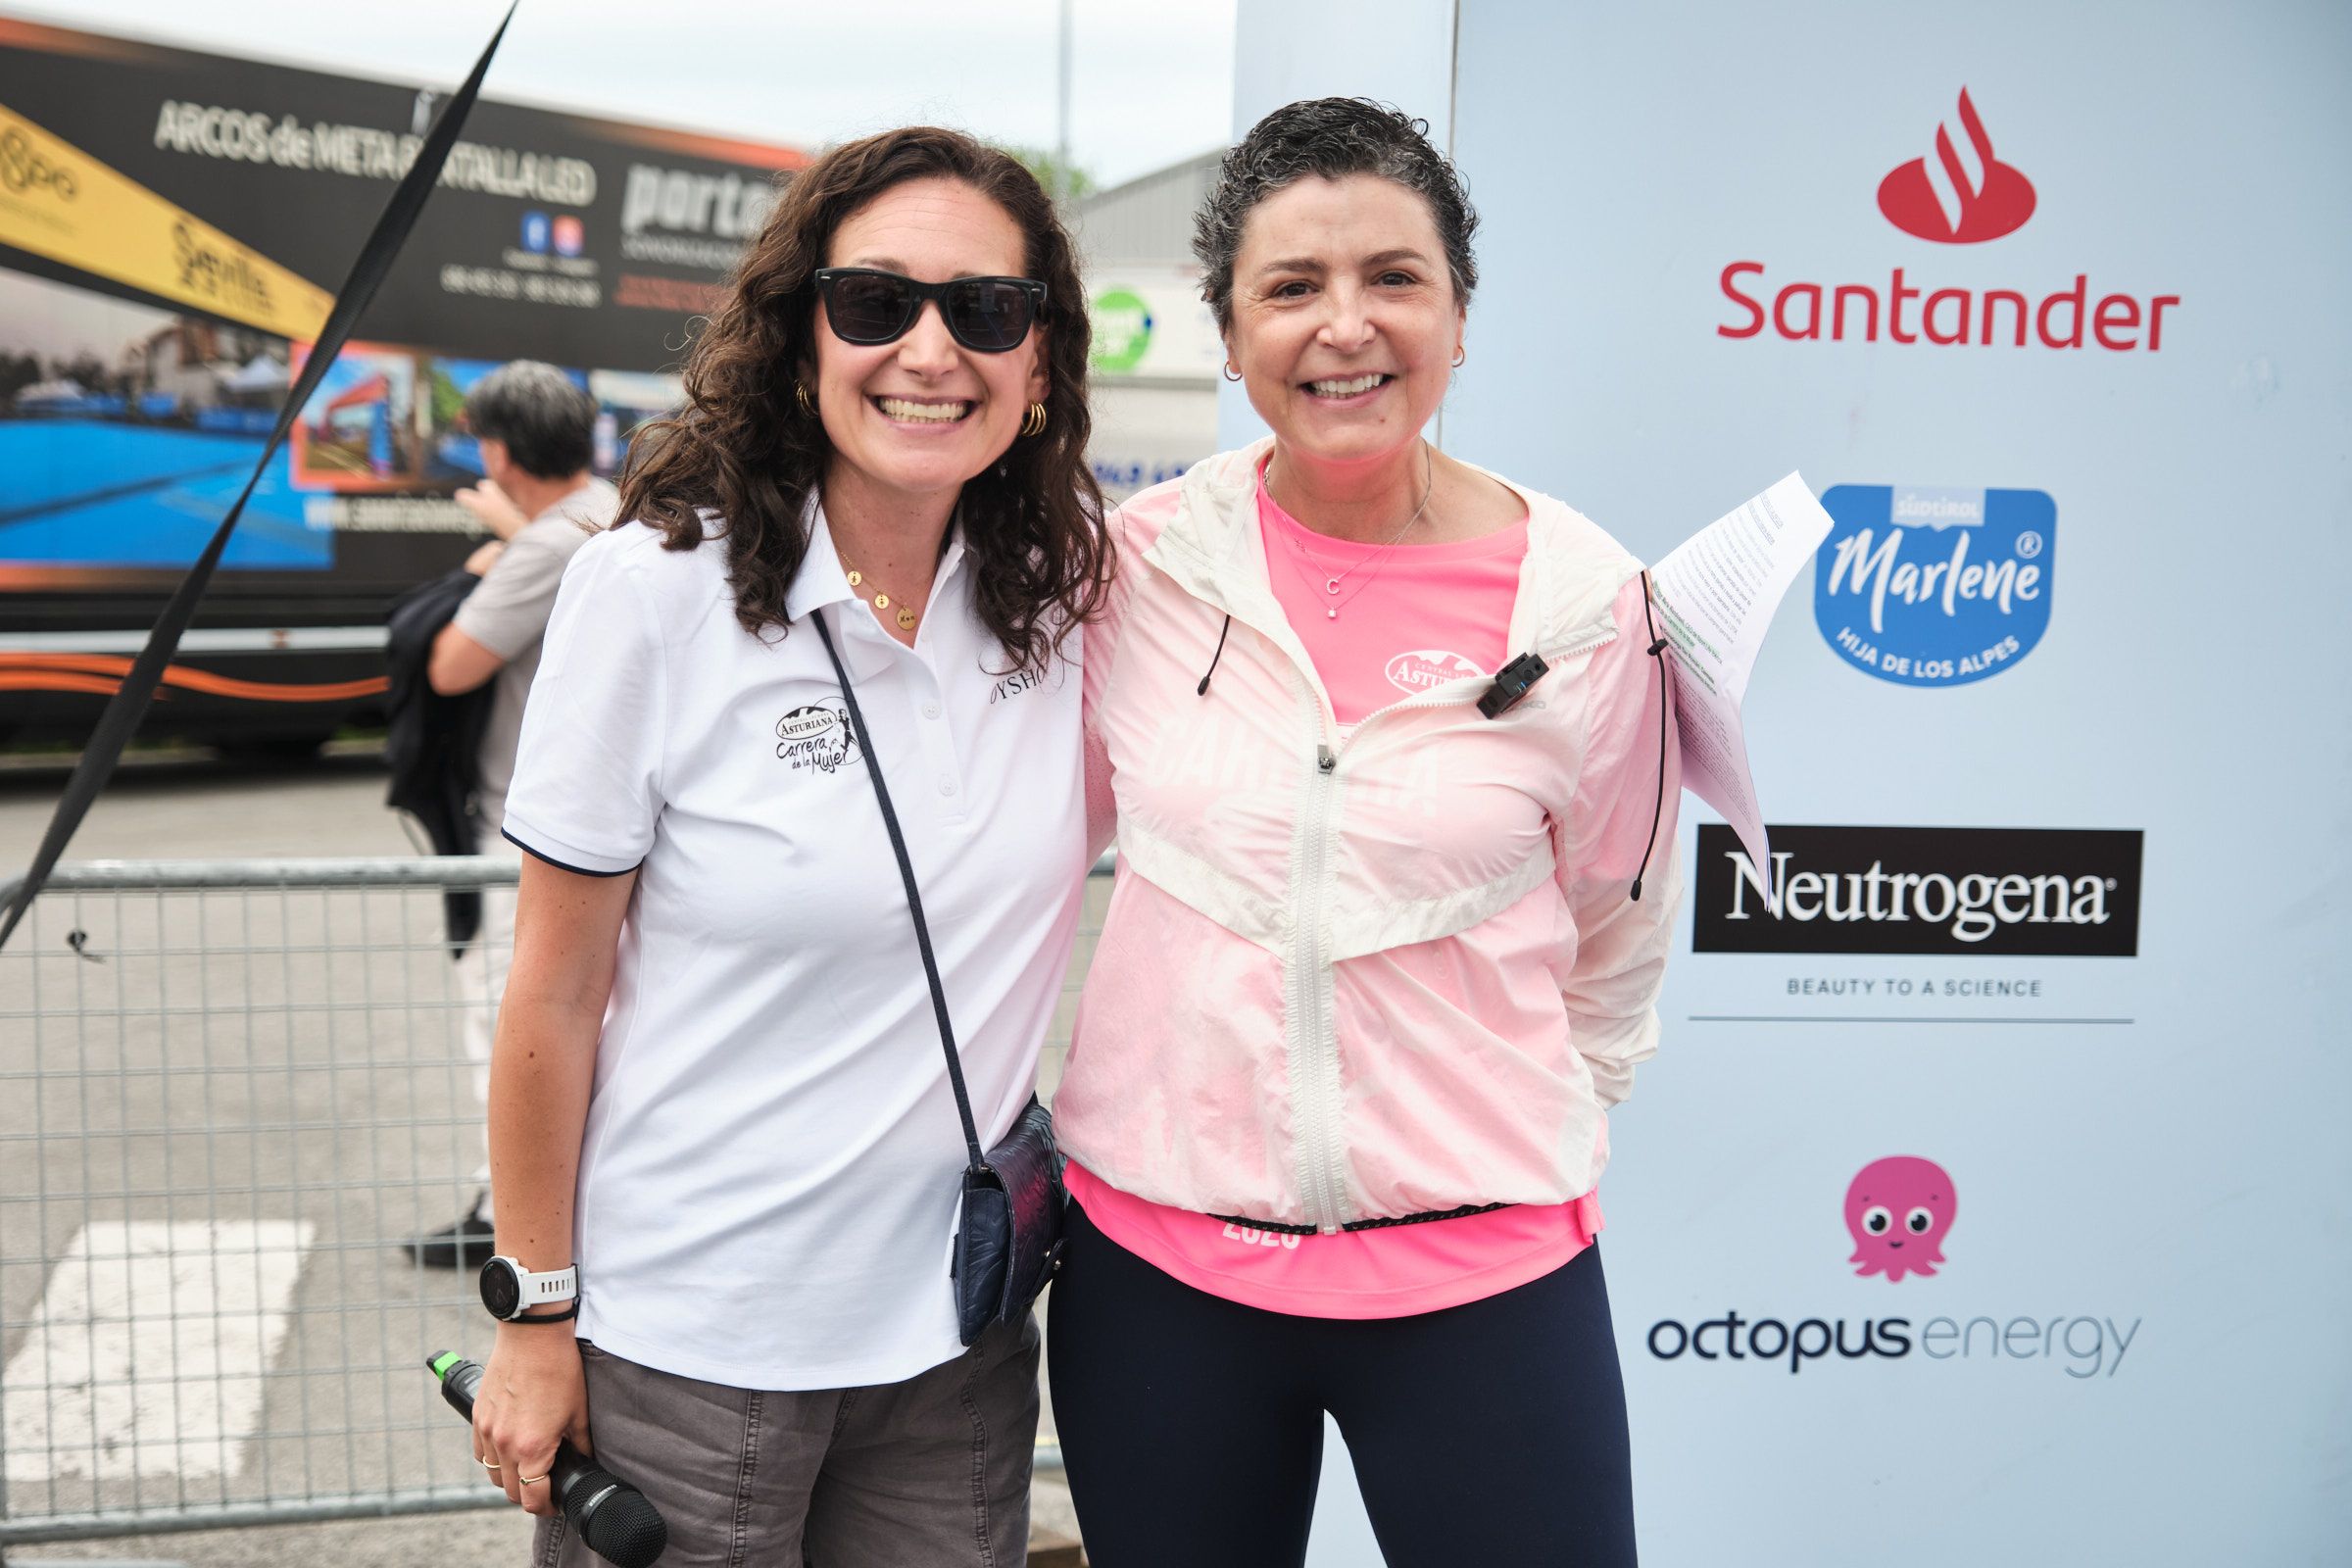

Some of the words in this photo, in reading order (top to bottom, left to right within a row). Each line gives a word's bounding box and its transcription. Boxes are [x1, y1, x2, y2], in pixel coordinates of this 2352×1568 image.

[154, 99, 272, 165] ARCOS
[270, 113, 313, 171] de
[313, 121, 399, 180] META
[1717, 262, 2181, 351] Santander
[1827, 527, 2041, 634] Marlene
[1836, 626, 1879, 666] HIJA
[1882, 653, 1911, 676] DE
[1914, 659, 1954, 678] LOS
[1958, 635, 2021, 676] ALPES
[776, 737, 828, 760] Carrera
[781, 715, 834, 736] ASTURIANA
[792, 756, 802, 769] de
[803, 755, 811, 767] la
[1724, 851, 2111, 943] Neutrogena
[1787, 978, 1877, 996] BEAUTY
[1885, 979, 1914, 997] TO
[1921, 979, 1936, 997] A
[1942, 979, 2042, 998] SCIENCE
[1646, 1310, 1911, 1374] octopus
[1921, 1314, 2143, 1380] energy
